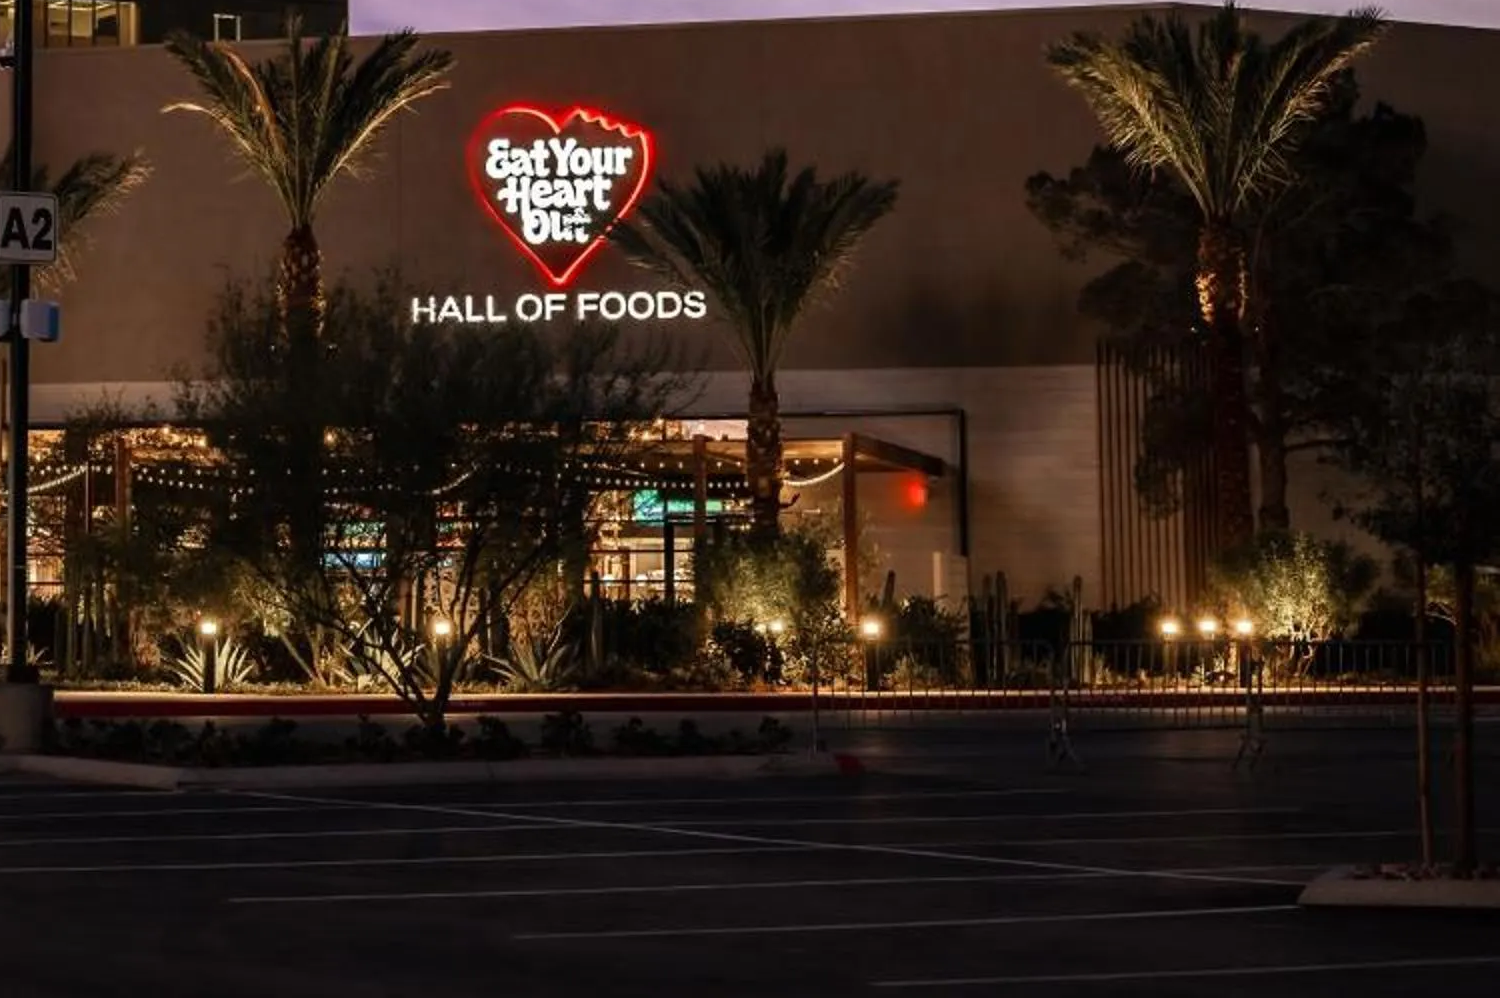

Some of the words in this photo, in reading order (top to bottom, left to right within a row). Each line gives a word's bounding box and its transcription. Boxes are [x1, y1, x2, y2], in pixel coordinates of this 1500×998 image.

[485, 138, 550, 178] Eat
[548, 137, 633, 176] Your
[497, 176, 613, 213] Heart
[1, 207, 53, 251] A2
[522, 208, 591, 245] Out
[412, 295, 507, 323] HALL
[515, 293, 567, 321] OF
[577, 291, 708, 320] FOODS
